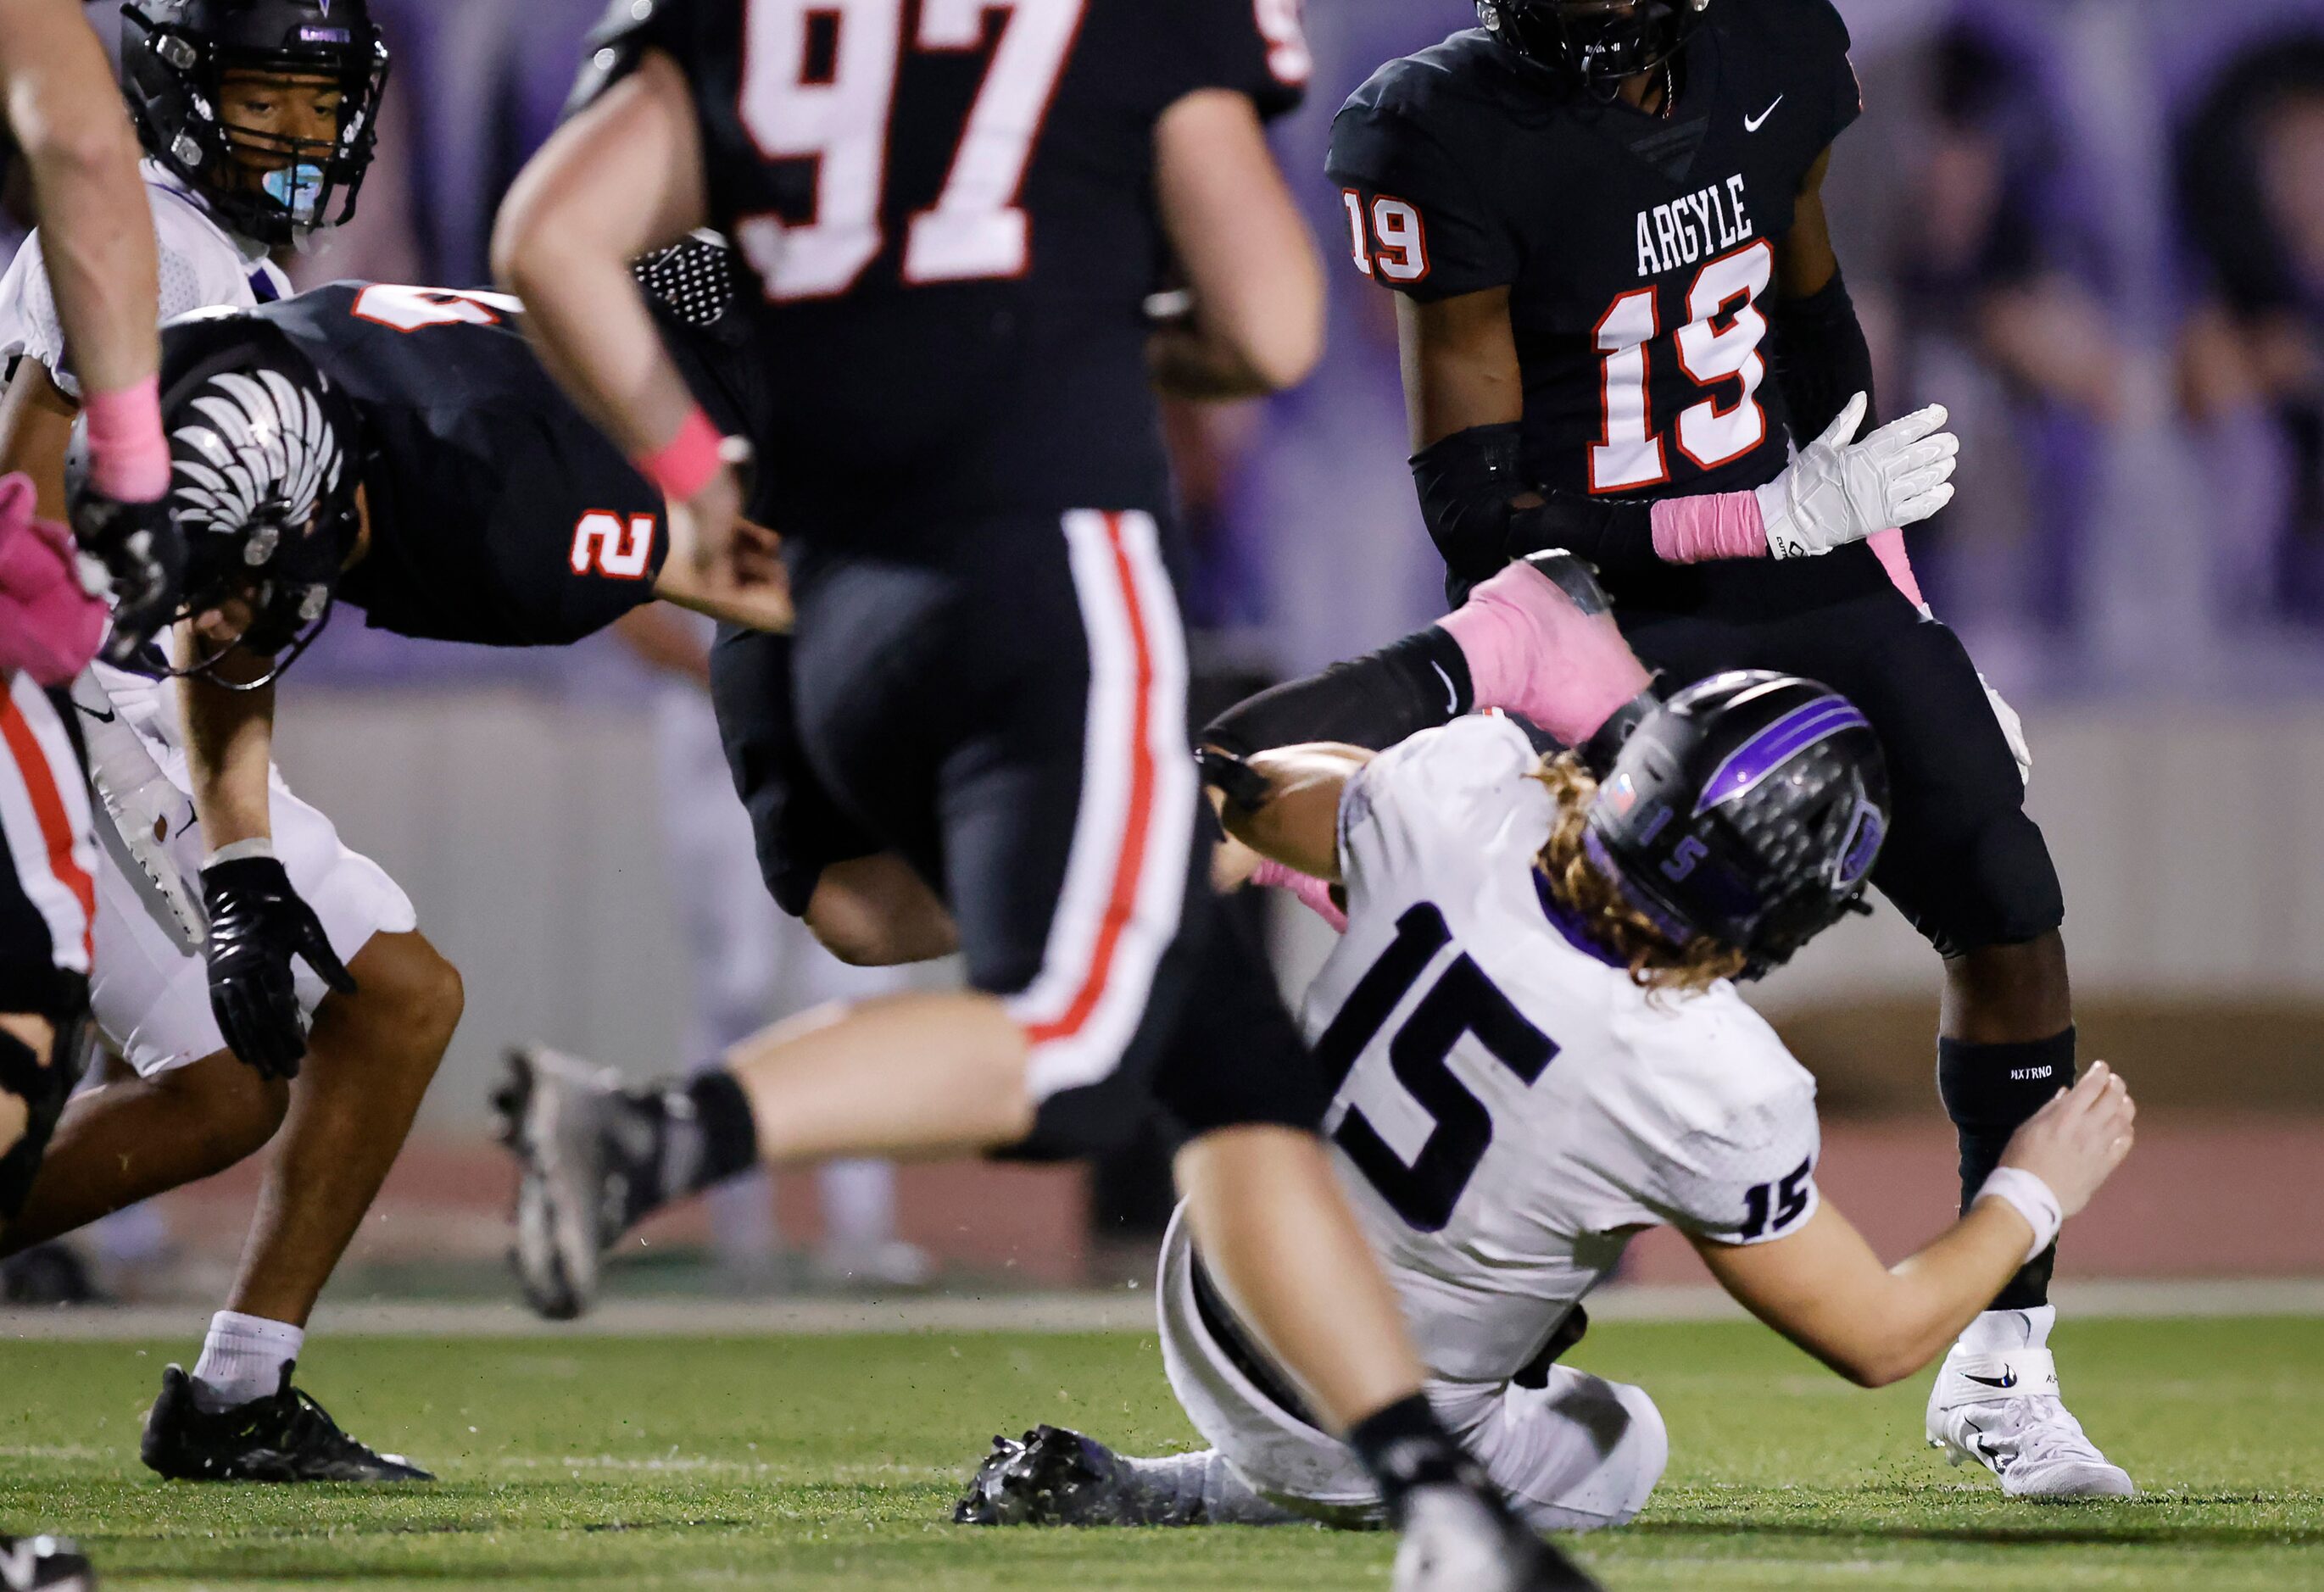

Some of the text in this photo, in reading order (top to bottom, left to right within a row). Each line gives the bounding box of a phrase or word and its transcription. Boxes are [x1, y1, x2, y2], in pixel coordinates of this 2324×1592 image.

[735, 0, 1090, 304] 97
[1342, 187, 1430, 282] 19
[1636, 172, 1753, 277] ARGYLE
[1587, 236, 1775, 494] 19
[569, 508, 656, 580] 2
[1639, 805, 1709, 882] 15
[1312, 900, 1562, 1233] 15
[1740, 1155, 1811, 1240] 15
